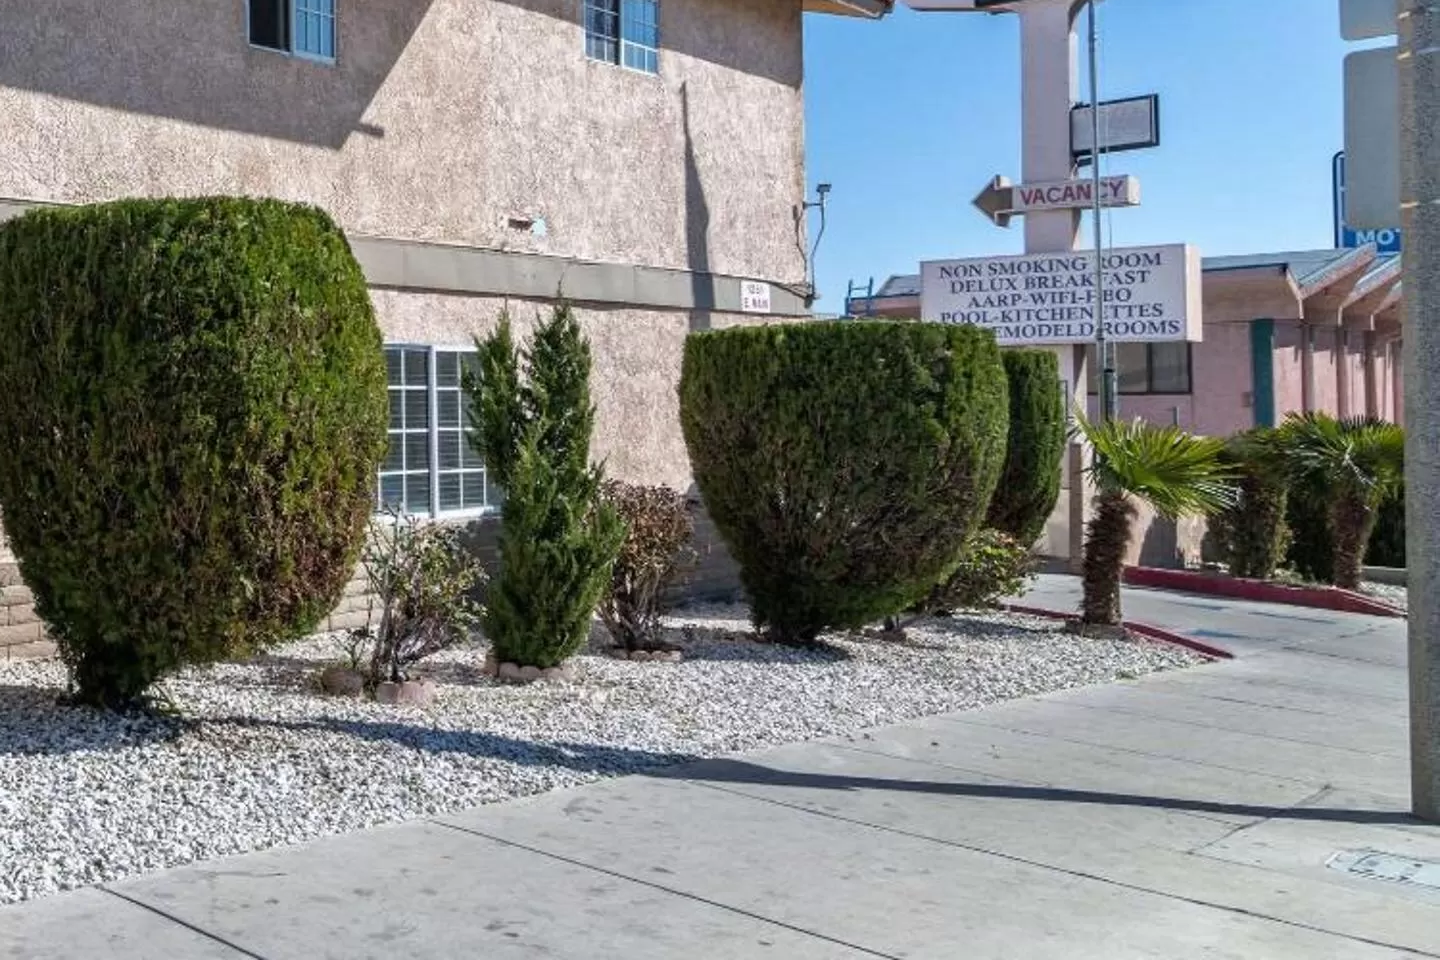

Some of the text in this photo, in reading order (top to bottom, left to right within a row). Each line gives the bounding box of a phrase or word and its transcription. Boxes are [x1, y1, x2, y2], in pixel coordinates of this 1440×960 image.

[1356, 228, 1400, 245] MO
[939, 264, 983, 279] NON
[987, 257, 1088, 277] SMOKING
[951, 277, 1018, 294] DELUX
[990, 322, 1095, 338] EMODELD
